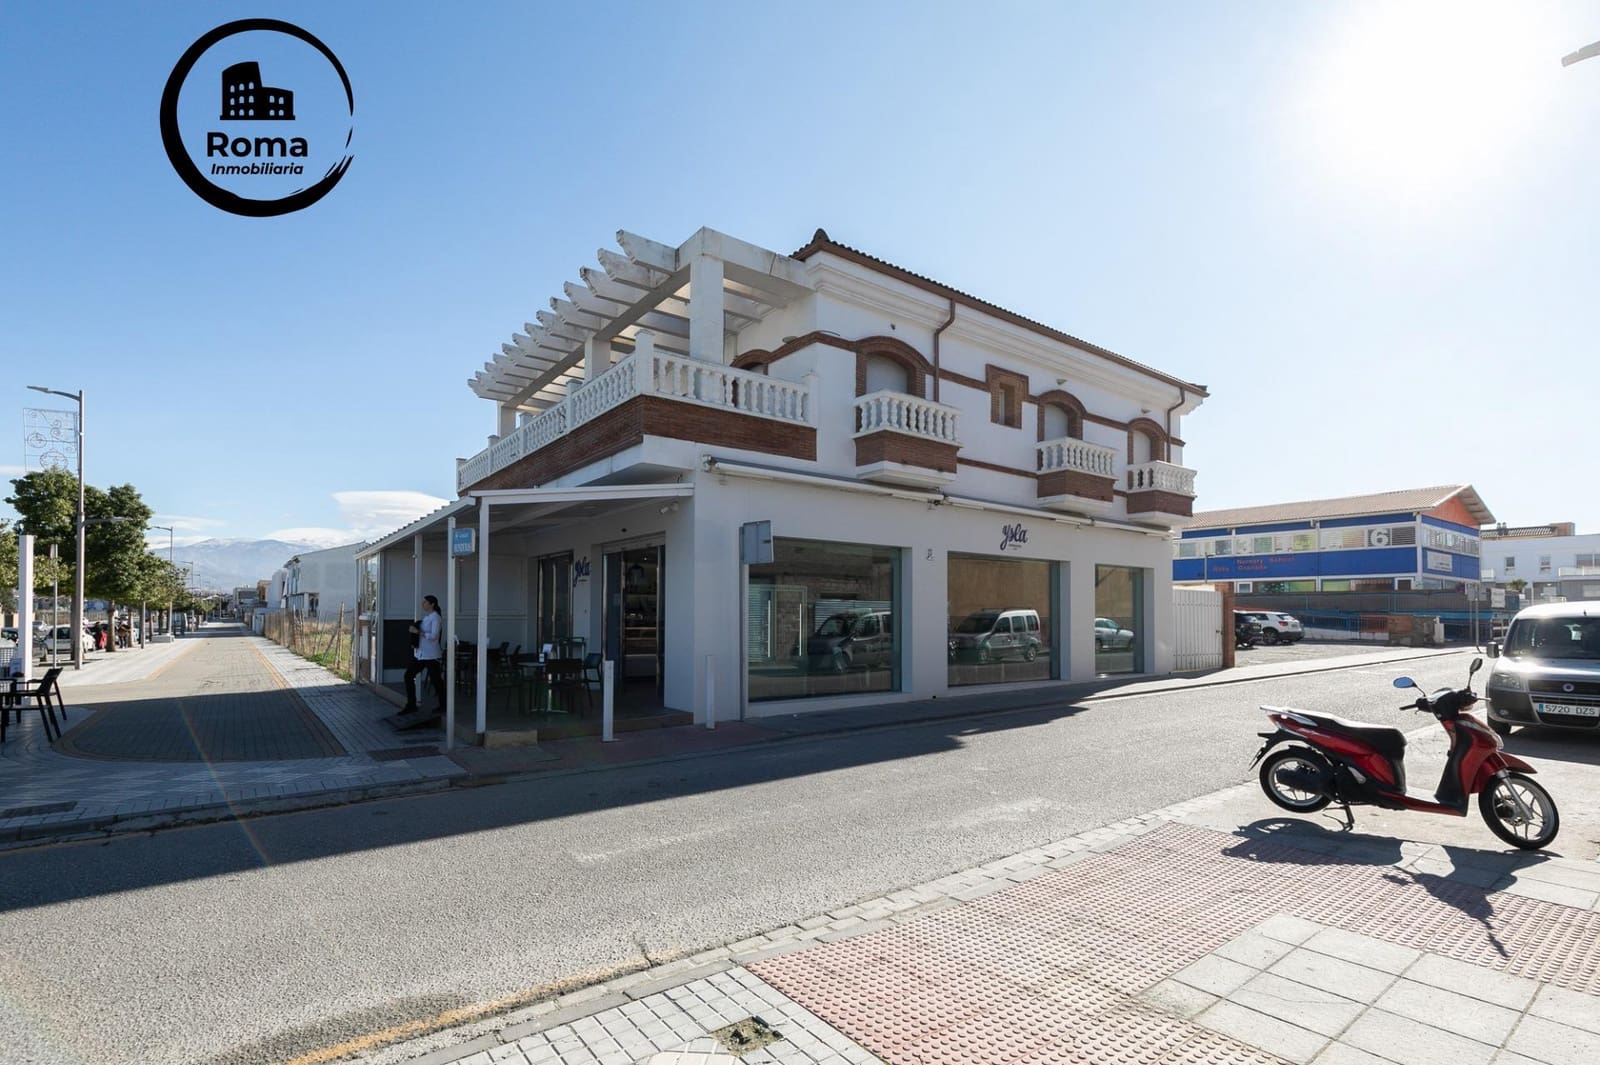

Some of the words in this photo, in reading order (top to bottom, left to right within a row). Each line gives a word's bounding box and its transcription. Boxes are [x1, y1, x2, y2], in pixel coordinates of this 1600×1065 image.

[1371, 527, 1389, 546] 6
[1545, 704, 1570, 713] 5720
[1575, 706, 1596, 716] DZS
